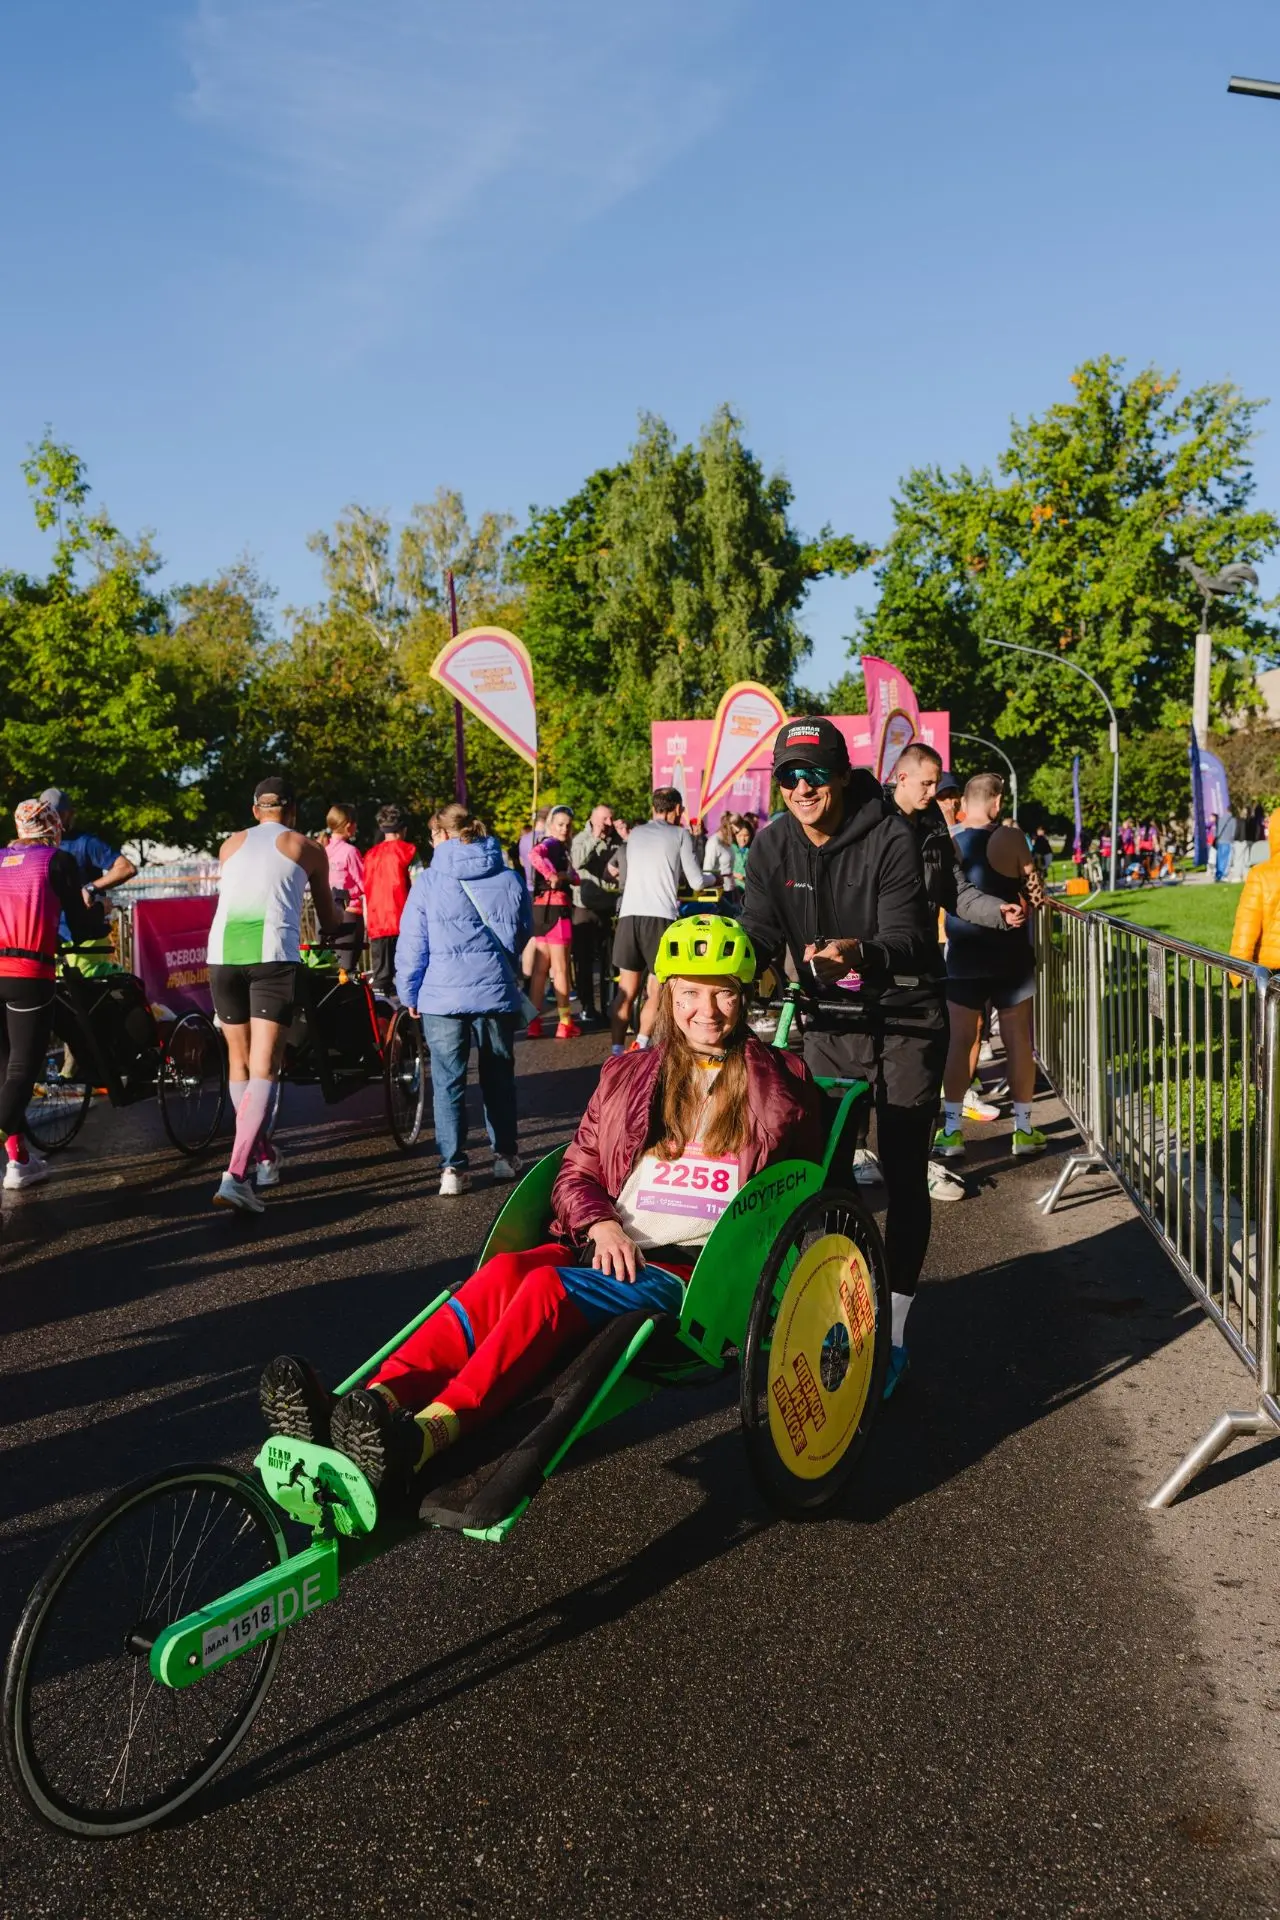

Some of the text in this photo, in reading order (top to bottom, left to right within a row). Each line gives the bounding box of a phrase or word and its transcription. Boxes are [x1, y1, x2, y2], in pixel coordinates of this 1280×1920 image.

[653, 1162, 730, 1193] 2258
[706, 1203, 717, 1214] 11
[791, 1386, 810, 1426] ЧЕМ
[794, 1354, 826, 1430] МОЖЕШЬ
[773, 1376, 806, 1451] БОЛЬШЕ
[267, 1446, 291, 1461] TEAM
[268, 1457, 289, 1471] HOYT
[232, 1605, 270, 1642] 1518
